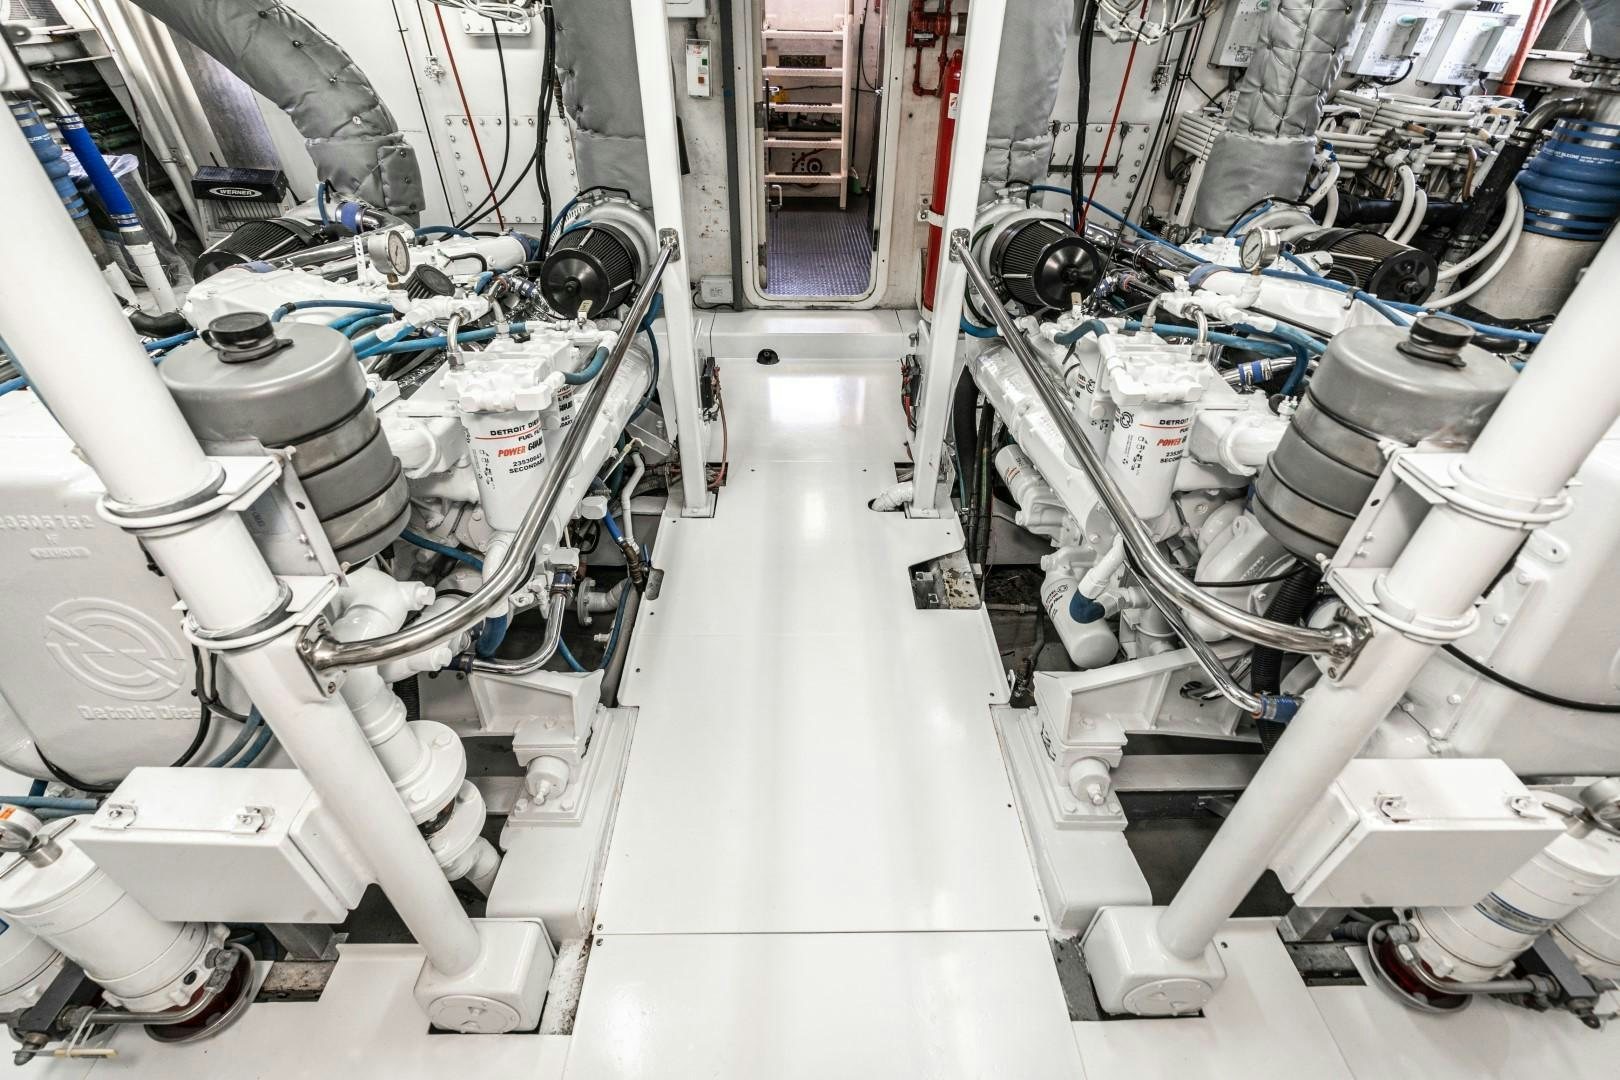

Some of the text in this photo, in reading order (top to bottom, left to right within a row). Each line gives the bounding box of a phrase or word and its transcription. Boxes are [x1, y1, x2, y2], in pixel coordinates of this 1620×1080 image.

[1159, 417, 1189, 426] DETROIT
[490, 424, 526, 436] DETROIT
[518, 433, 533, 441] FUEL
[497, 446, 526, 457] POWER
[78, 704, 157, 720] Detroit
